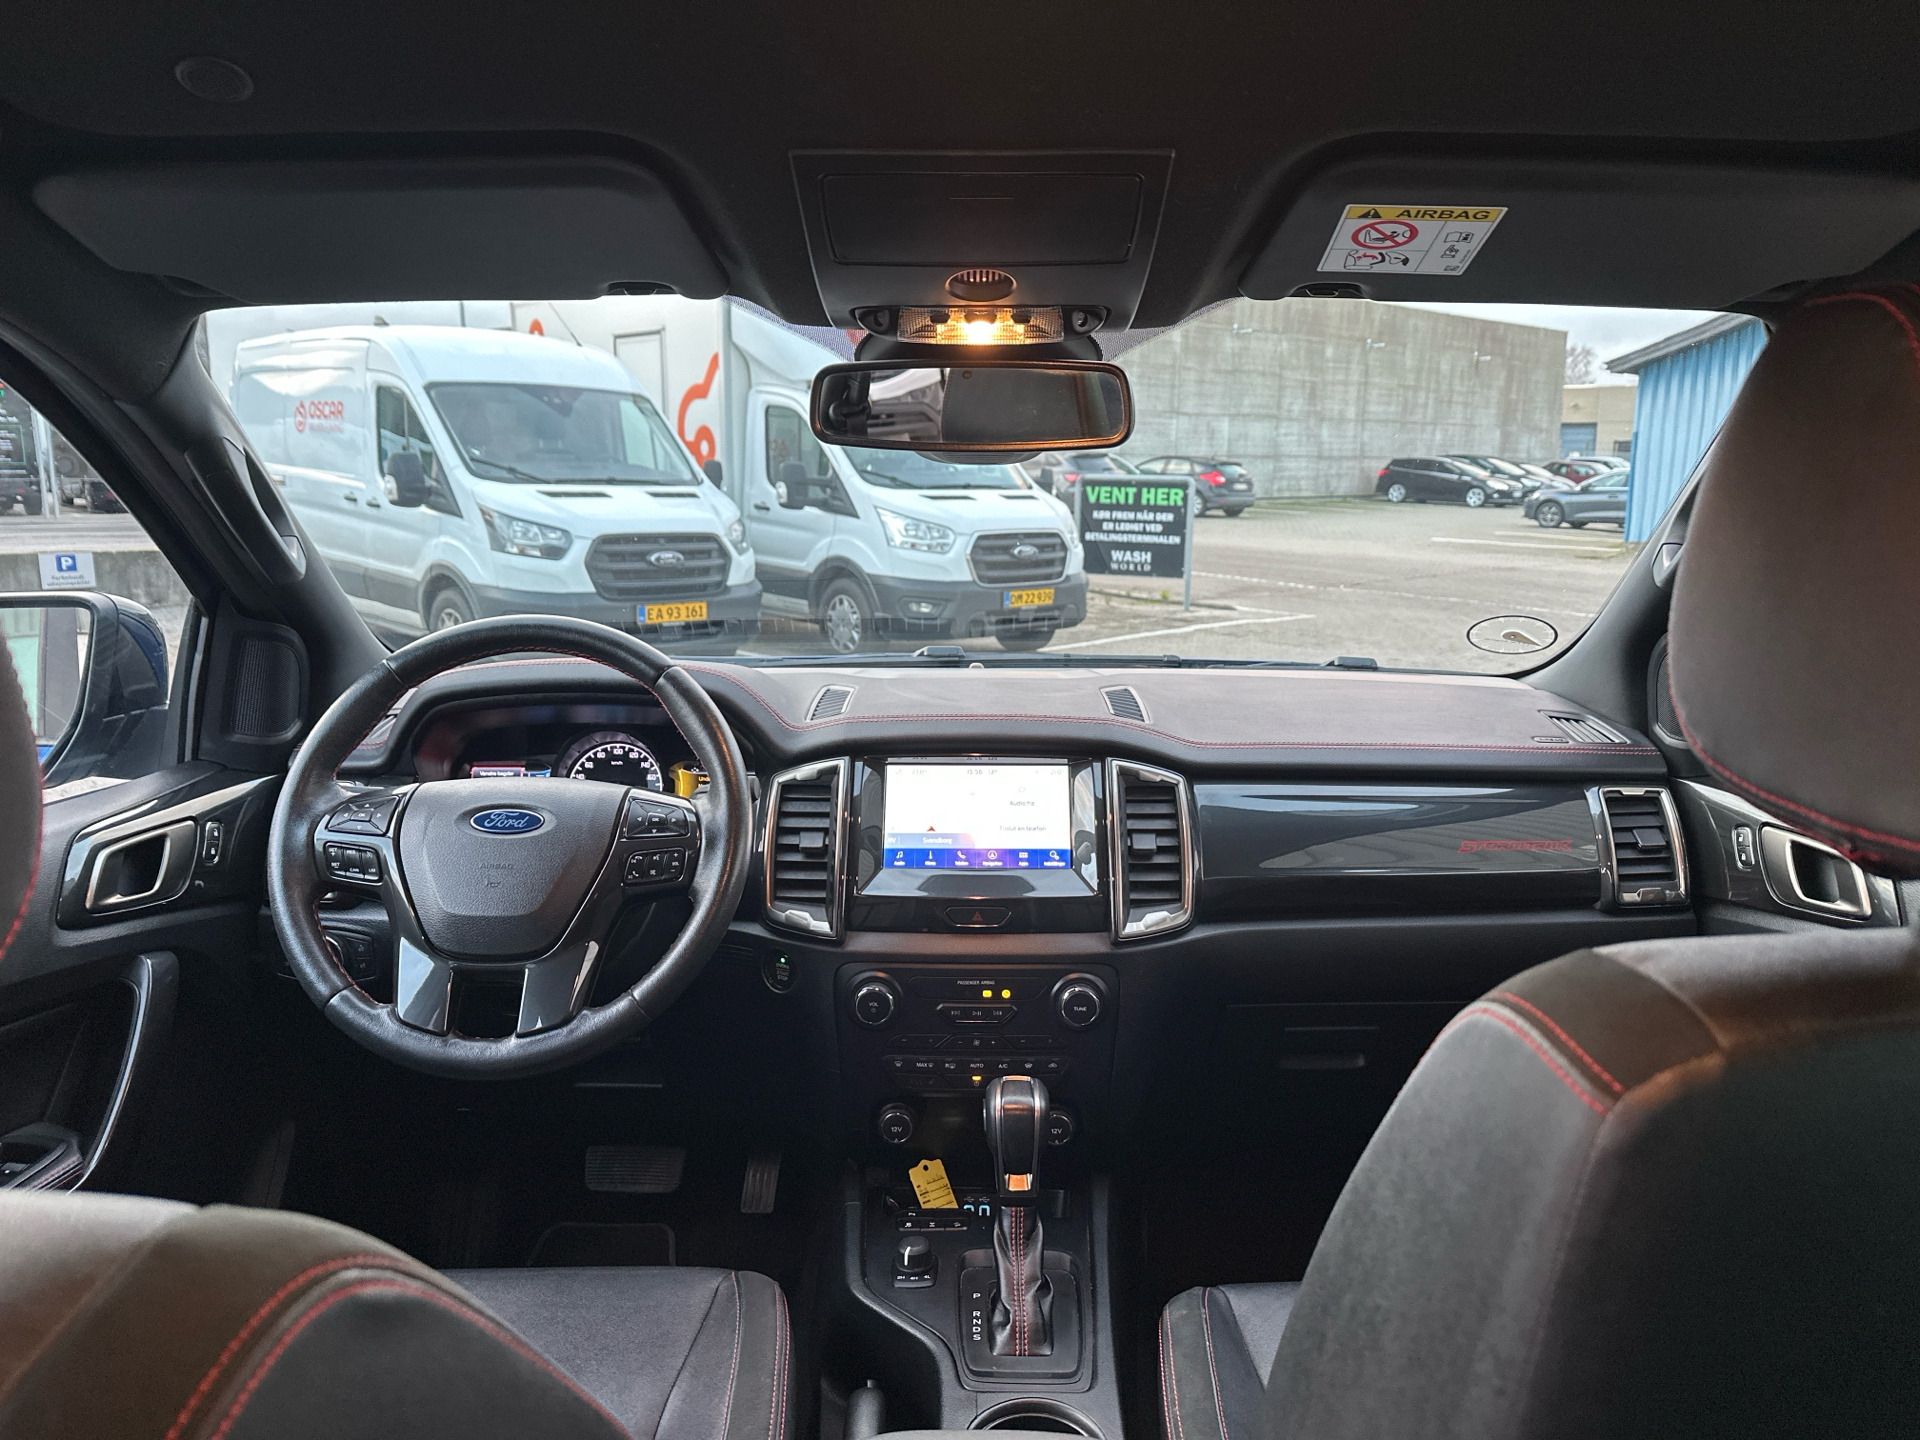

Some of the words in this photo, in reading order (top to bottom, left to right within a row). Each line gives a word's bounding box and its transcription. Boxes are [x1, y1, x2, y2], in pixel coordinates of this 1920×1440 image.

[1396, 209, 1490, 220] AIRBAG
[308, 400, 343, 419] OSCAR
[1085, 486, 1137, 505] VENT
[1140, 487, 1184, 506] HER
[1092, 510, 1111, 520] KØR
[1112, 511, 1135, 521] FREM
[1136, 510, 1155, 521] NÅR
[1155, 512, 1175, 522] DER
[1102, 521, 1114, 531] ER
[1115, 522, 1145, 532] LEDIGT
[1145, 523, 1163, 533] VED
[1084, 532, 1181, 545] BETALINGSTERMINALEN
[1110, 550, 1152, 563] WASH
[60, 556, 74, 571] P
[1110, 562, 1152, 572] WORLD
[1024, 592, 1035, 604] 22
[646, 607, 664, 621] EA
[666, 606, 682, 620] 93
[684, 605, 704, 618] 161
[484, 811, 530, 828] Ford
[922, 837, 953, 845] Svendborg
